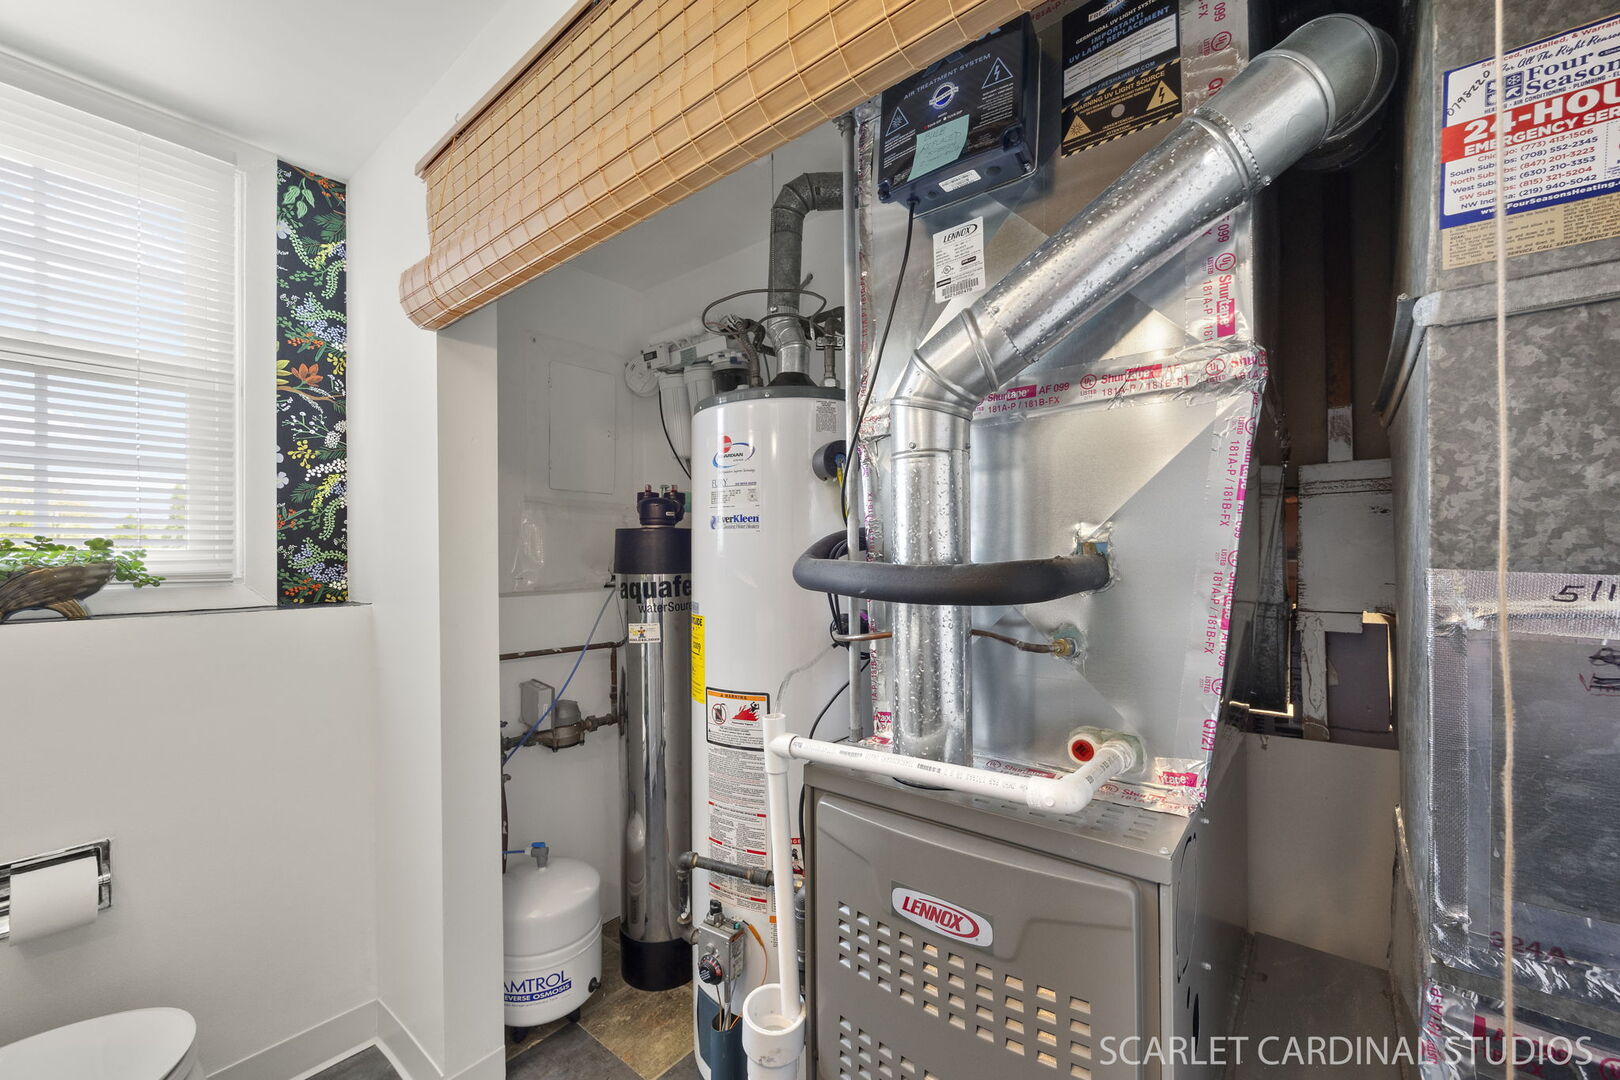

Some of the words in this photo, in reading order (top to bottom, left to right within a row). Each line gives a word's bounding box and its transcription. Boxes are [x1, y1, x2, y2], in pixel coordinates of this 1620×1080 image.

[1069, 53, 1080, 64] UV
[1081, 39, 1105, 57] LAMP
[1106, 5, 1171, 43] REPLACEMENT
[1527, 52, 1594, 81] Four
[1073, 95, 1104, 113] WARNING
[1104, 90, 1115, 101] UV
[1136, 70, 1166, 88] SOURCE
[1449, 167, 1476, 178] South
[1520, 149, 1547, 162] (708)
[1549, 135, 1599, 154] 552-2345
[1520, 140, 1547, 153] (773)
[1549, 127, 1595, 144] 413-1506
[1450, 176, 1475, 187] North
[1520, 158, 1547, 170] (847)
[1548, 146, 1596, 163] 201-3223
[1452, 185, 1475, 194] West
[1519, 168, 1547, 179] (630)
[1549, 155, 1597, 172] 210-3353
[1458, 193, 1475, 202] SW
[1519, 177, 1544, 188] (815)
[1545, 165, 1593, 182] 321-5204
[1461, 201, 1479, 210] NW
[1518, 186, 1543, 198] (219)
[1545, 174, 1598, 191] 940-5042
[943, 226, 972, 243] LENNOX
[1039, 384, 1052, 395] AF
[1053, 382, 1070, 392] 099
[1227, 440, 1240, 476] 181A-P
[1219, 485, 1234, 527] 181B-FX
[902, 895, 964, 932] LENNOX
[532, 982, 571, 1000] OSMOSIS
